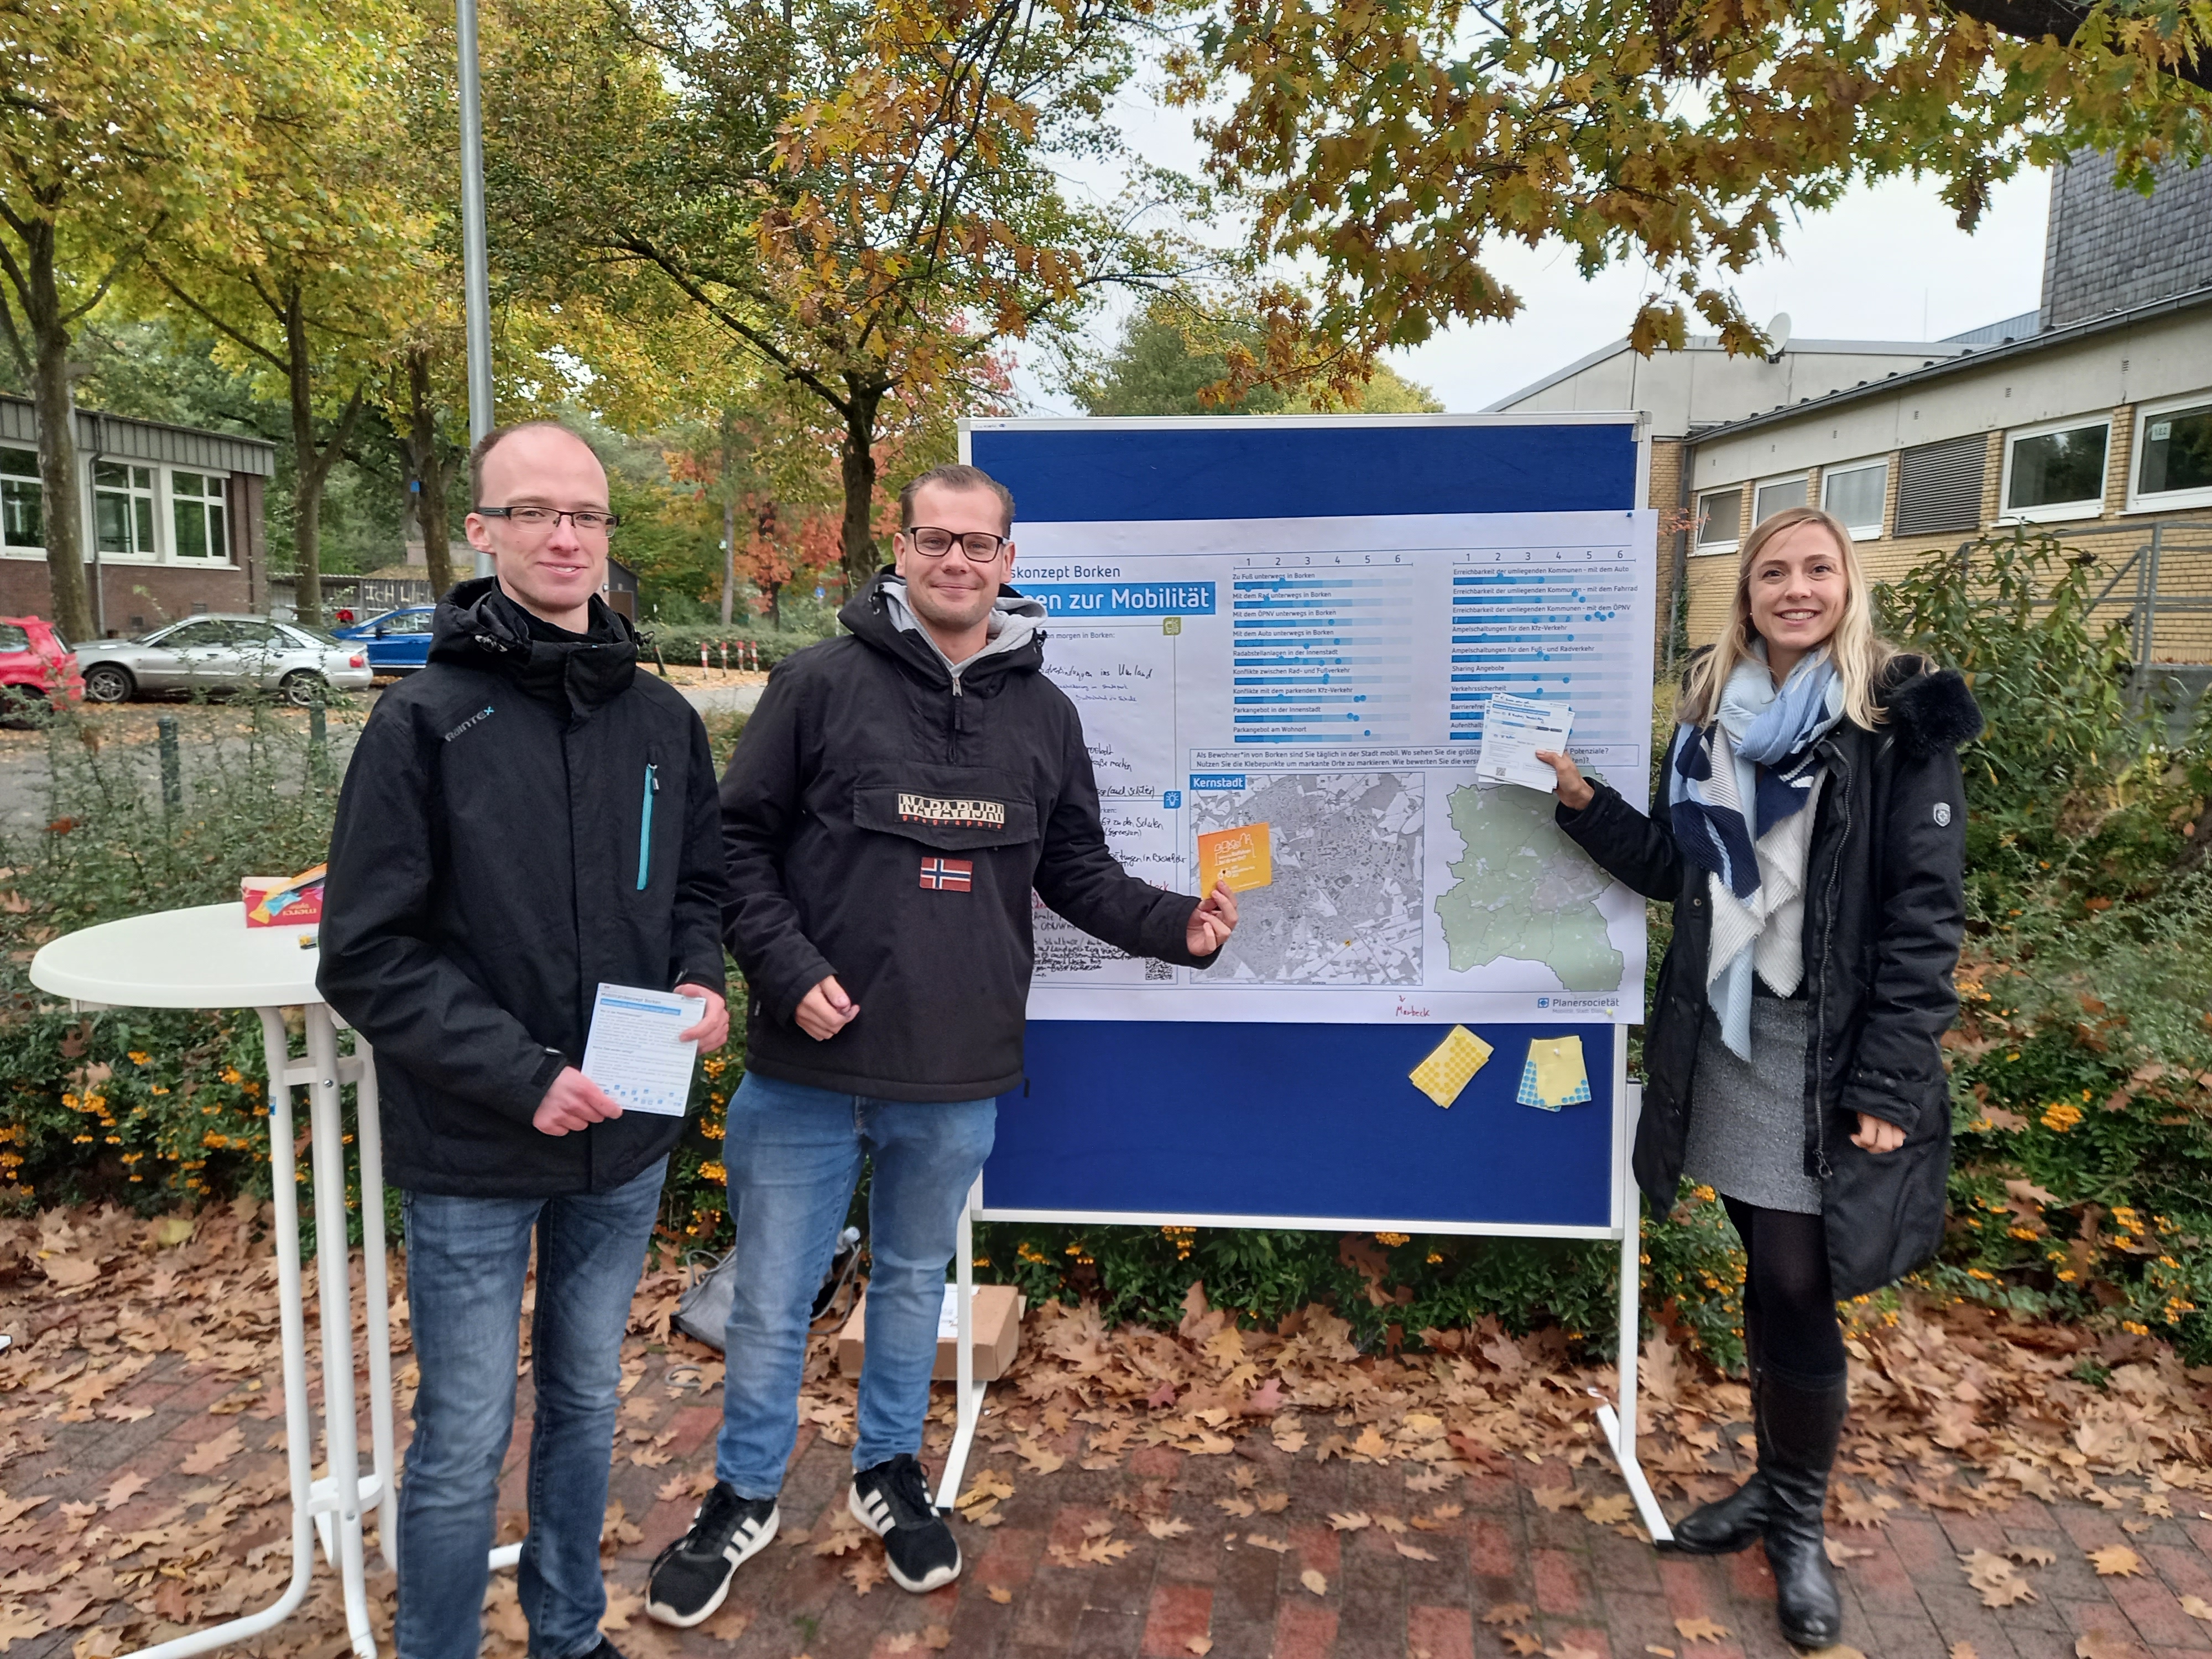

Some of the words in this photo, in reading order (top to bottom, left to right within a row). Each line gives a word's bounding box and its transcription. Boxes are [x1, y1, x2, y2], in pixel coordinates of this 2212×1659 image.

[1587, 551, 1592, 559] 5
[1618, 550, 1623, 559] 6
[1365, 555, 1370, 564] 5
[1395, 555, 1401, 563] 6
[1010, 565, 1070, 581] skonzept
[1074, 565, 1120, 577] Borken
[1068, 593, 1104, 609] zur
[1112, 587, 1209, 609] Mobilität
[1193, 778, 1243, 787] Kernstadt
[900, 794, 1004, 822] NAPAPIJRI
[282, 907, 316, 916] merci
[1553, 998, 1619, 1006] Planersocietät
